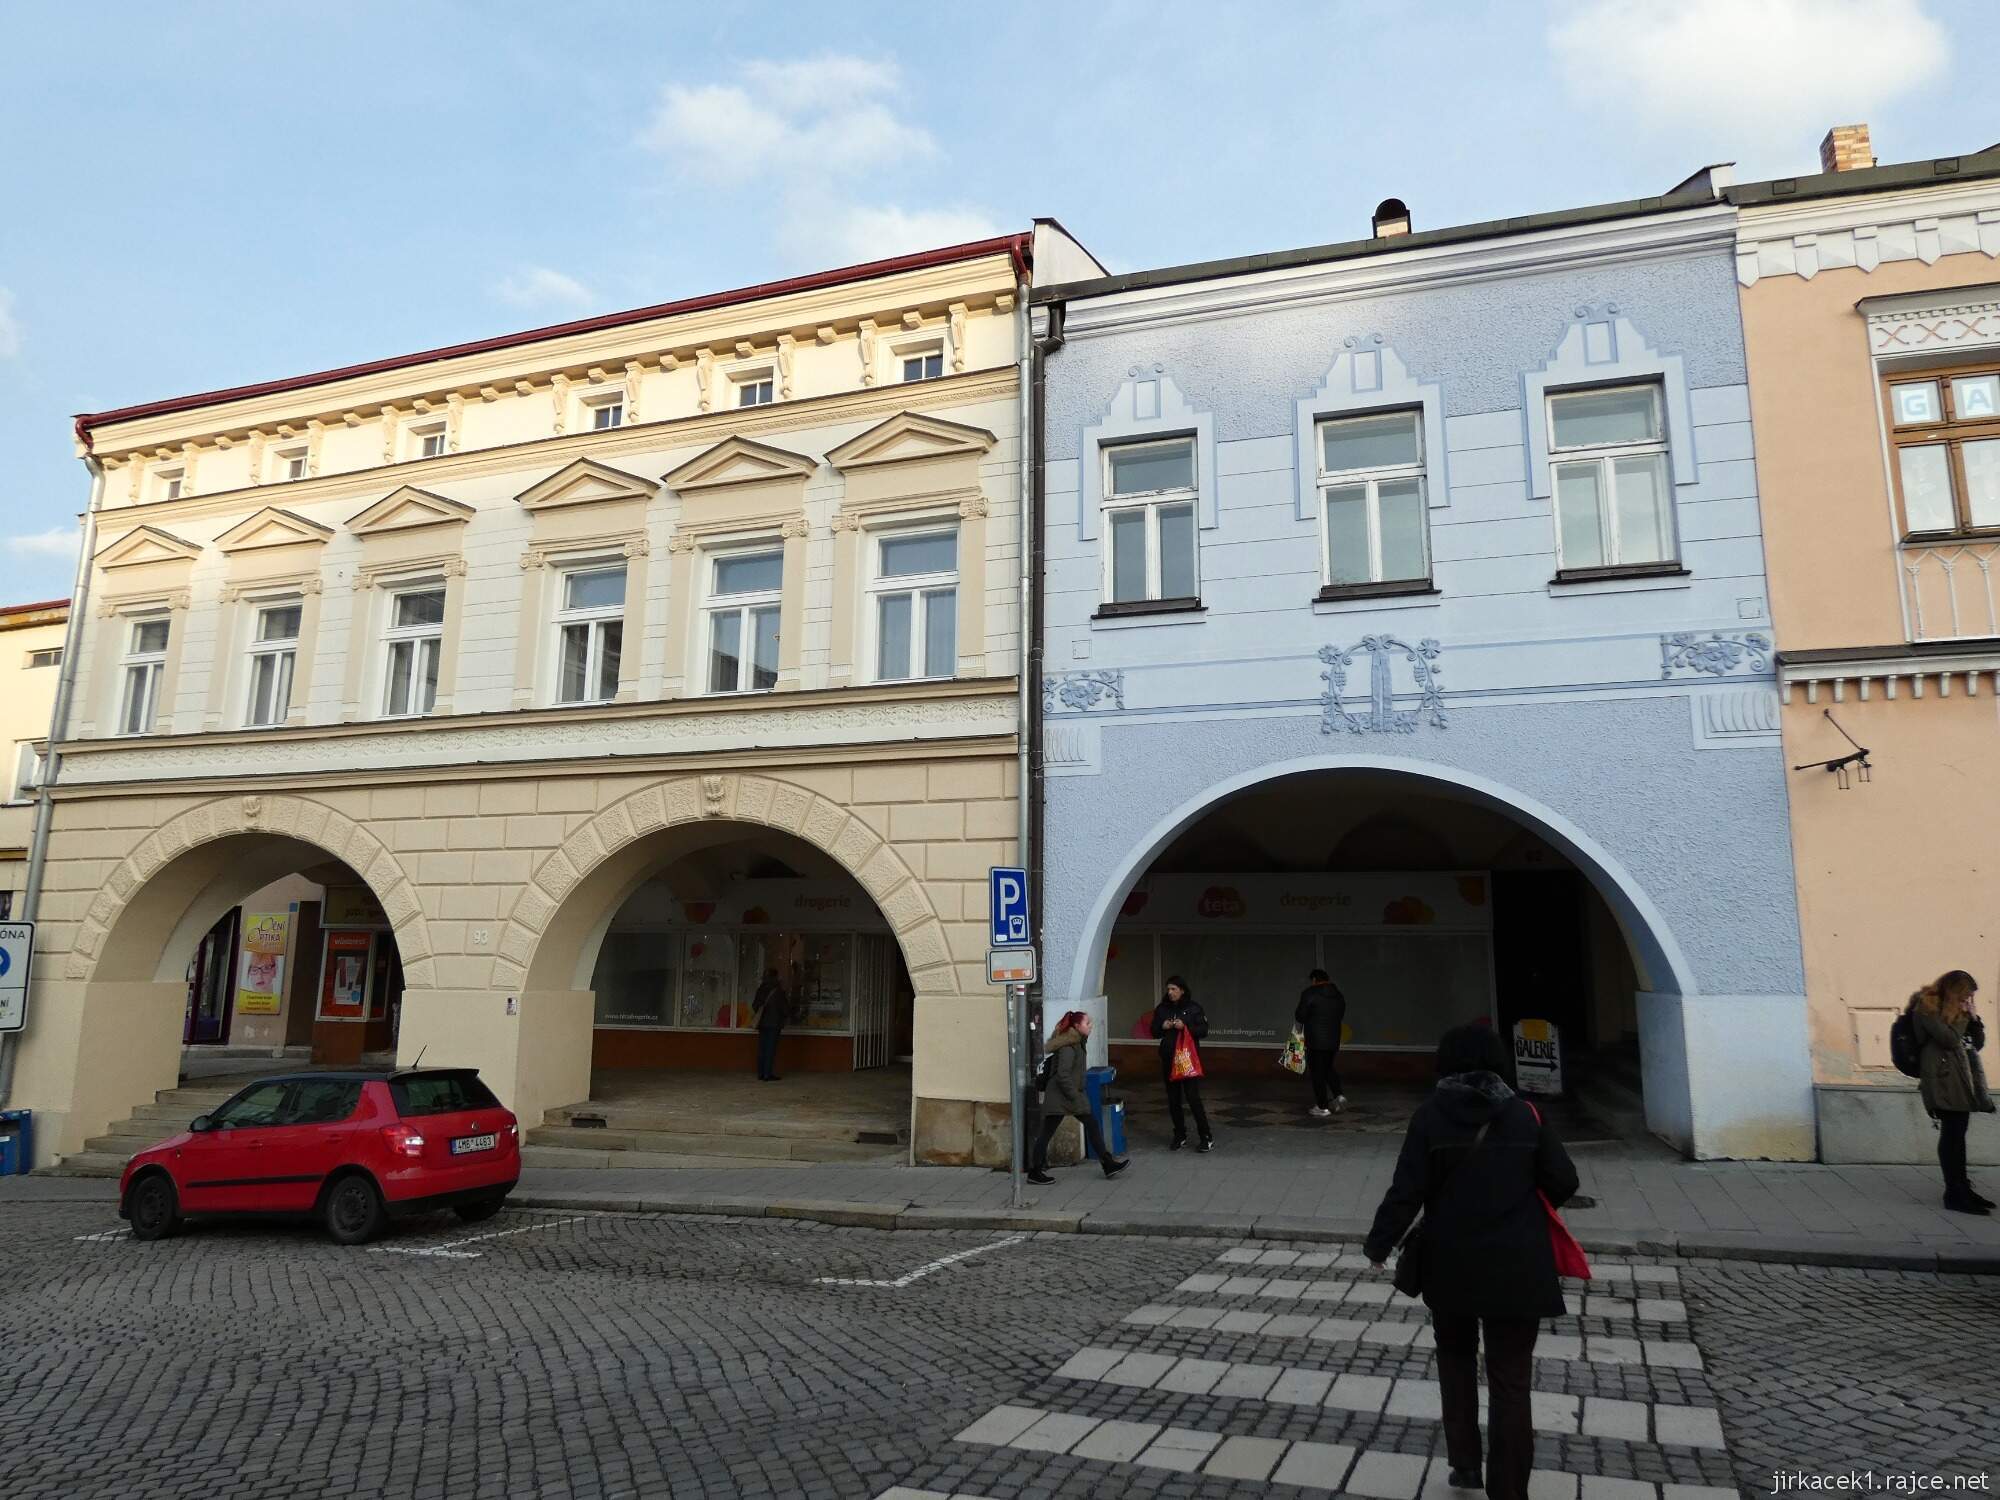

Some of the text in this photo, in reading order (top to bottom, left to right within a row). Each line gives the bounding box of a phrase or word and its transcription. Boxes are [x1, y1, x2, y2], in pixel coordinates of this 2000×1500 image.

[1904, 388, 1992, 416] G A
[795, 894, 851, 911] drogerie
[999, 877, 1020, 920] P
[1280, 889, 1351, 911] drogerie
[473, 929, 489, 945] 93
[1516, 1039, 1556, 1059] GALERIE
